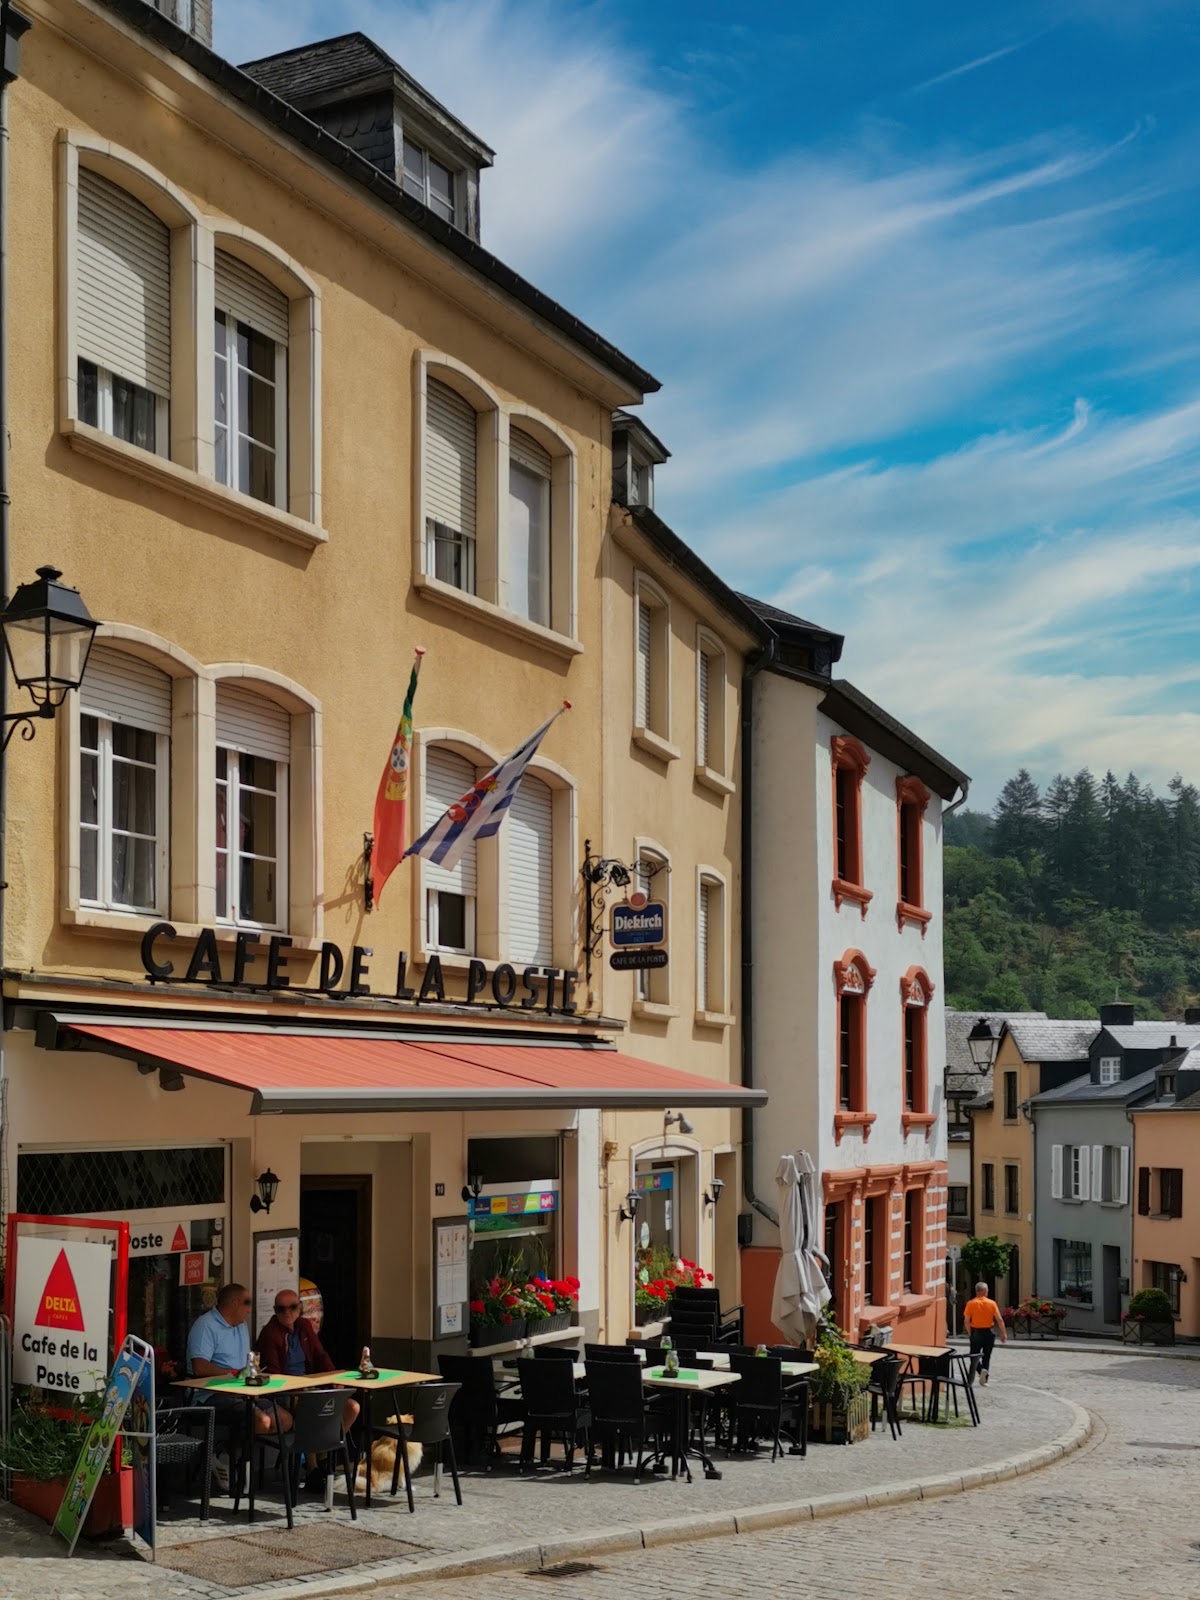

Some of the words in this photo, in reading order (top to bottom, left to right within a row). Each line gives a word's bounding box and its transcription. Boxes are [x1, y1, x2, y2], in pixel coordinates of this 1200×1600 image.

[615, 913, 662, 930] Diekirch
[629, 956, 637, 965] DE
[637, 955, 646, 964] LA
[646, 954, 666, 963] POSTE
[320, 942, 374, 995] DE
[396, 951, 445, 1001] LA
[467, 959, 579, 1014] POSTE
[128, 1233, 163, 1250] oste
[45, 1296, 77, 1313] DELTA
[22, 1333, 56, 1355] Cafe
[60, 1339, 79, 1359] de
[83, 1342, 98, 1362] la
[37, 1365, 80, 1389] Poste
